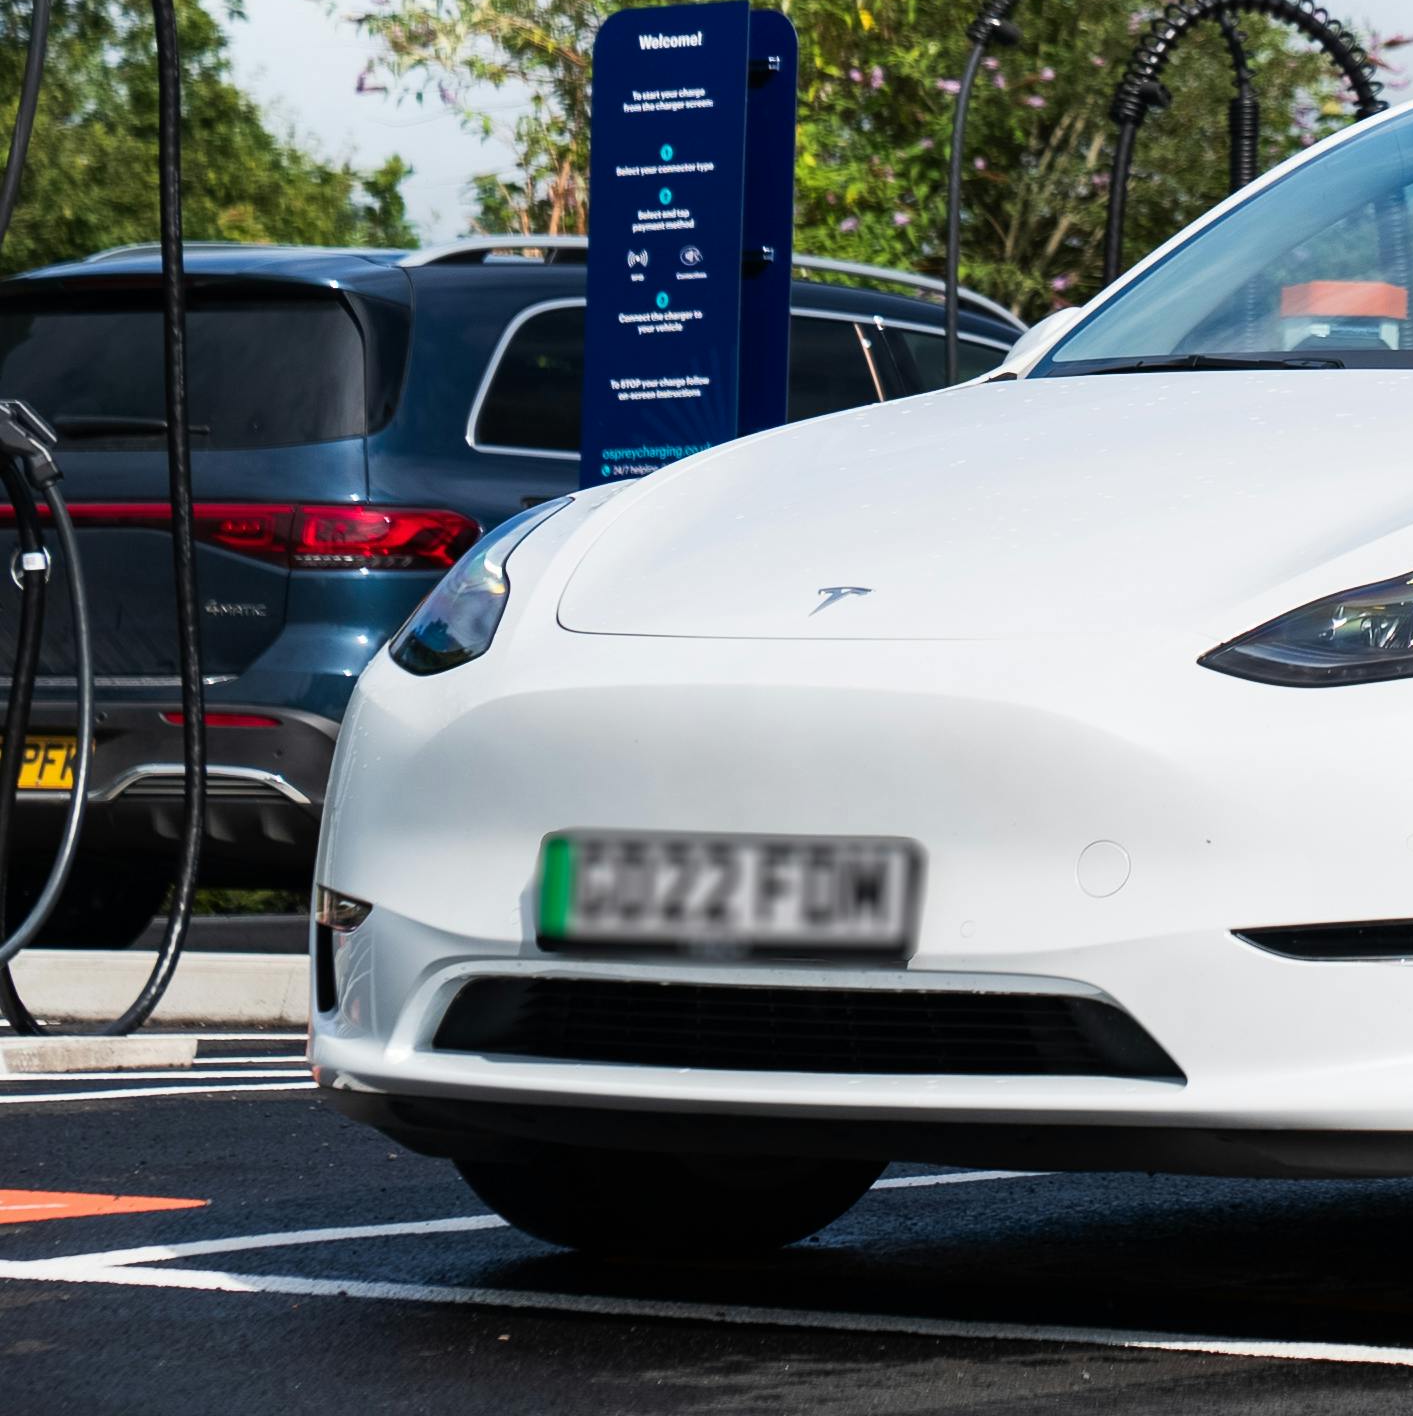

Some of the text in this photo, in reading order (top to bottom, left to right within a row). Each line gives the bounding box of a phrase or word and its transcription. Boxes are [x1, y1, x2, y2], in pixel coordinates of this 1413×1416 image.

[638, 30, 703, 51] Welcome!
[660, 89, 678, 100] your
[678, 87, 706, 99] charge
[623, 102, 642, 113] from
[642, 100, 655, 112] the
[656, 100, 685, 112] charger
[616, 161, 715, 177] Select your connector type
[637, 209, 661, 221] Select
[662, 208, 677, 220] and
[632, 217, 695, 234] payment method
[618, 309, 704, 324] Connect the charger to
[637, 321, 684, 336] your vehicle
[620, 378, 641, 390] STOP
[641, 379, 659, 390] your
[659, 377, 686, 389] charge
[686, 375, 710, 386] follow
